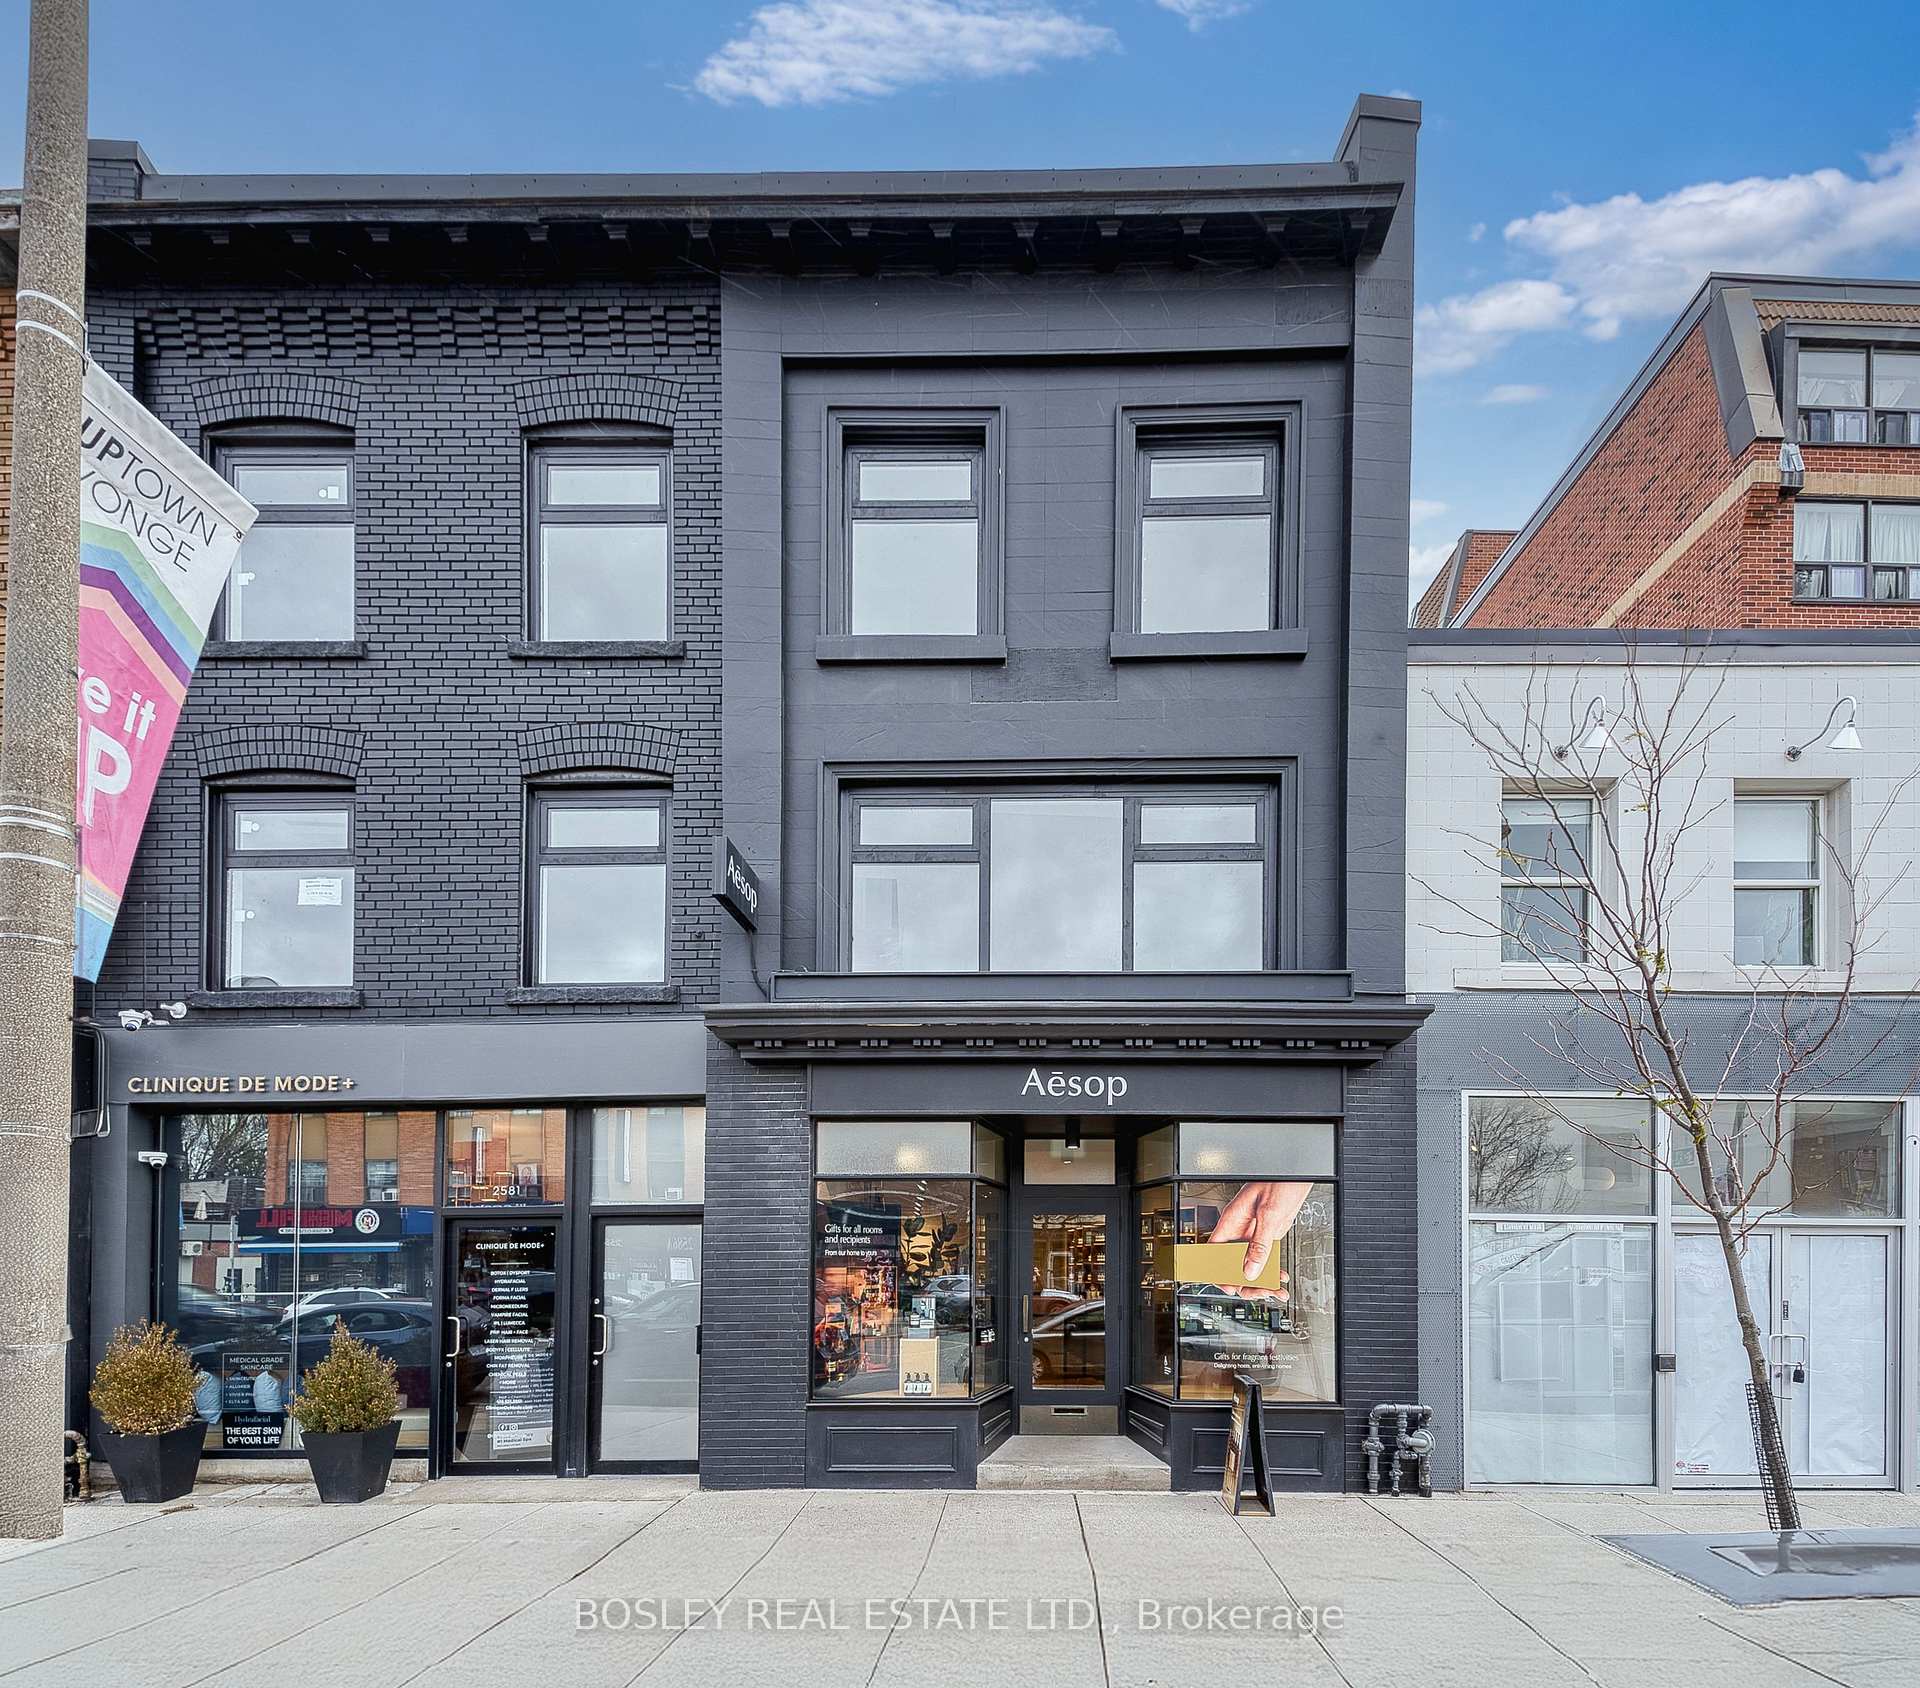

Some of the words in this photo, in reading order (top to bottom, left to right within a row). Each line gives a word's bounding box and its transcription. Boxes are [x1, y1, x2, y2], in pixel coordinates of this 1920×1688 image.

[80, 416, 217, 547] UPTOWN
[122, 691, 157, 742] it
[127, 1076, 230, 1093] CLINIQUE
[238, 1076, 266, 1092] DE
[1020, 1067, 1128, 1106] Aēsop
[492, 1185, 521, 1197] 2581
[824, 1224, 841, 1234] Gifts
[842, 1224, 853, 1234] for
[854, 1224, 862, 1234] all
[475, 1242, 508, 1250] CLINIQUE
[509, 1242, 519, 1250] DE
[824, 1234, 839, 1244] and
[840, 1235, 871, 1247] recipients
[1213, 1352, 1230, 1361] Gifts
[1231, 1352, 1241, 1361] for
[225, 1426, 241, 1435] THE
[241, 1426, 261, 1435] BEST
[262, 1426, 282, 1435] SKIN
[227, 1436, 239, 1445] OF
[239, 1436, 262, 1445] YOUR
[263, 1436, 280, 1445] LIFE
